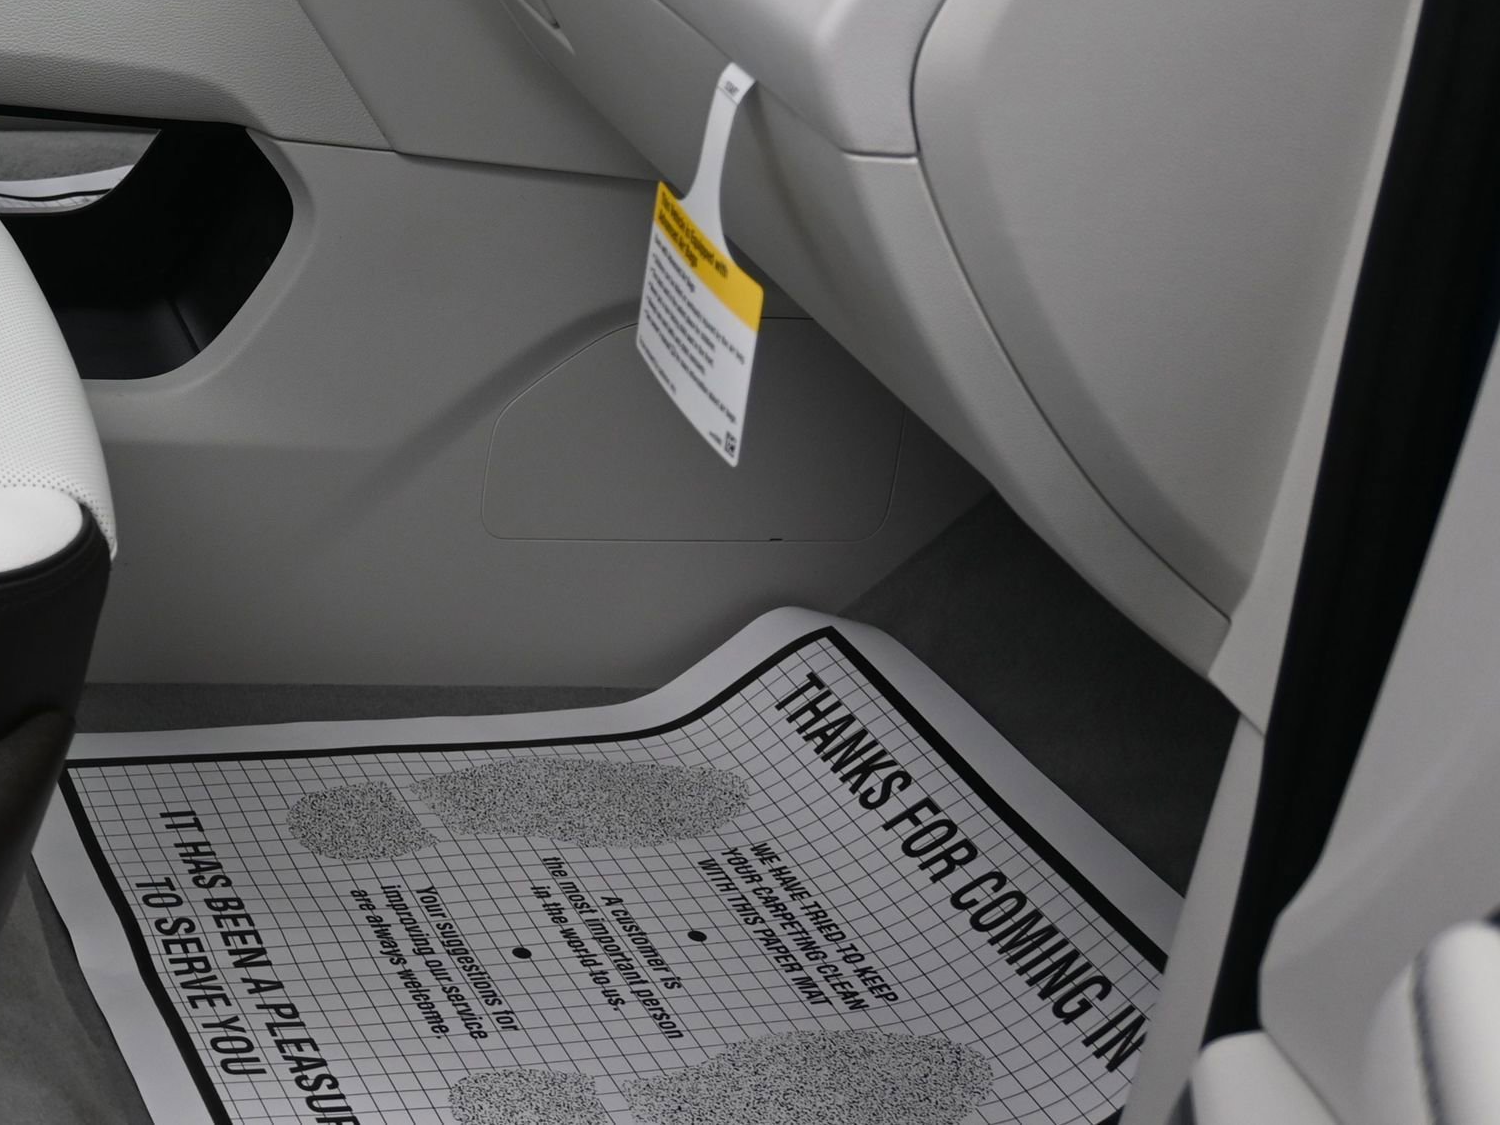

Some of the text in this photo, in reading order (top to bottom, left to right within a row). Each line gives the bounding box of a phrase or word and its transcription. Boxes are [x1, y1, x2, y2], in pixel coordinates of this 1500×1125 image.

[159, 810, 205, 832] IT
[173, 841, 233, 889] HAS
[775, 672, 1148, 1073] THANKS FOR COMING IN
[135, 877, 267, 1075] TO SERVE YOU
[203, 897, 273, 968] BEEN
[240, 977, 284, 994] A
[350, 889, 450, 1039] are always welcome.
[381, 885, 488, 1040] improving our service
[416, 886, 519, 1031] Your suggestions for
[530, 886, 626, 1011] in the world to us.
[543, 856, 684, 1039] the most important person
[601, 896, 682, 990] A customer is
[698, 858, 833, 1005] WITH THIS PAPER MAT
[721, 847, 870, 1011] YOUR CARPETING CLEAN
[750, 842, 899, 1002] WE HAVE TRIED TO KEEP
